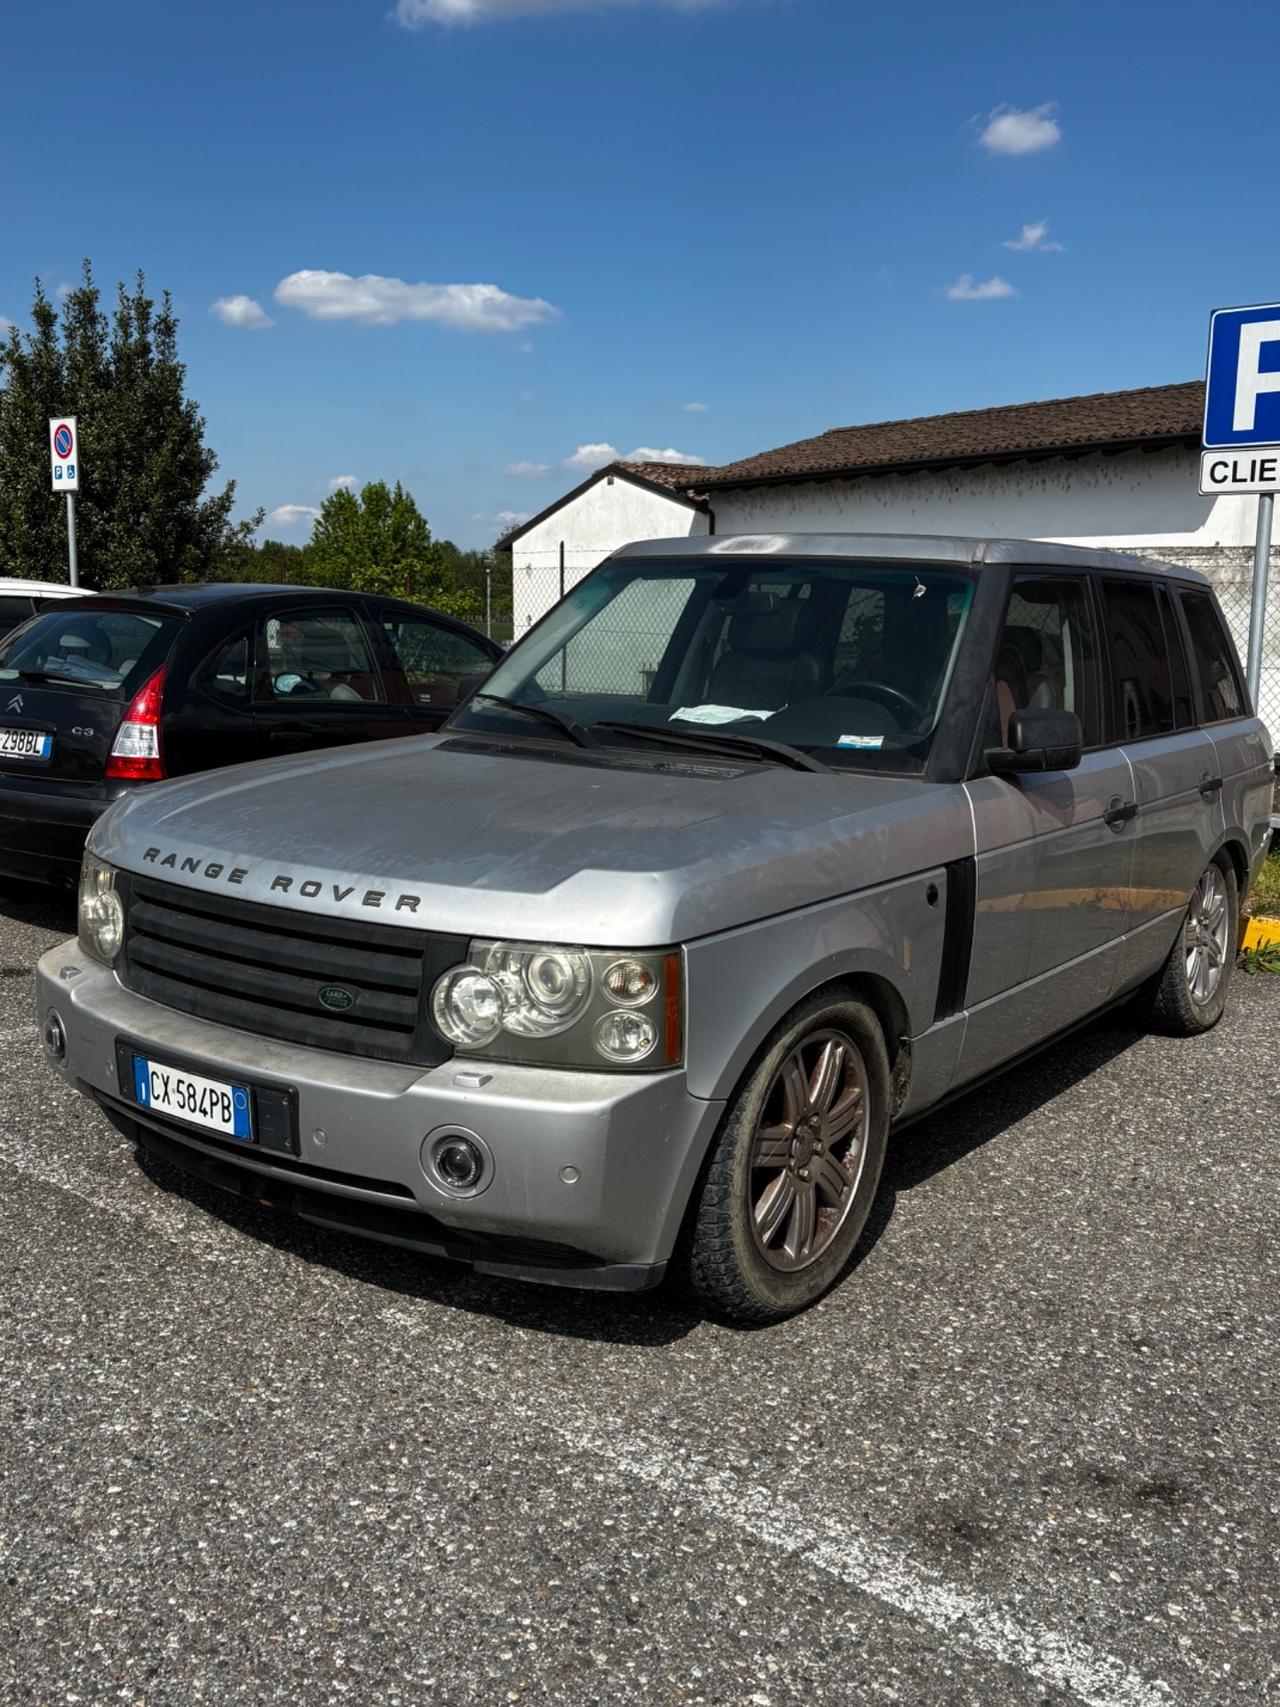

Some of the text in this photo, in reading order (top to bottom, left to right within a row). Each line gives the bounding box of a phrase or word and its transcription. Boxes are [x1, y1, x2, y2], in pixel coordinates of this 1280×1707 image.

[1232, 320, 1280, 431] P
[71, 726, 95, 737] C3
[142, 847, 421, 913] RANGE ROVER
